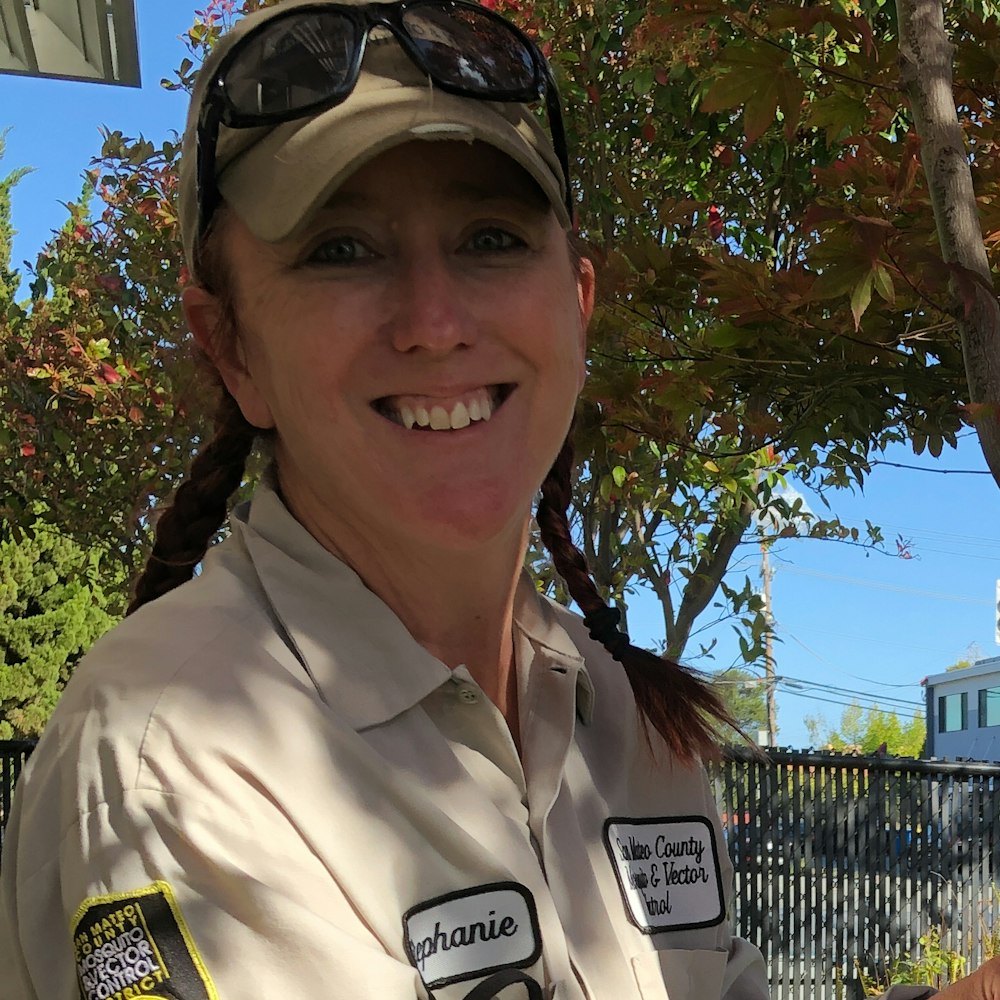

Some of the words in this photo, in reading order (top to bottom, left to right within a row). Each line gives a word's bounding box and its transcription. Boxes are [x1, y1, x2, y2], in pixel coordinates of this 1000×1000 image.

[655, 835, 705, 864] County
[650, 863, 660, 888] &
[662, 861, 709, 886] Vector
[90, 905, 134, 936] MATEO
[78, 927, 143, 974] MOSQUITO
[410, 910, 519, 972] ephanie
